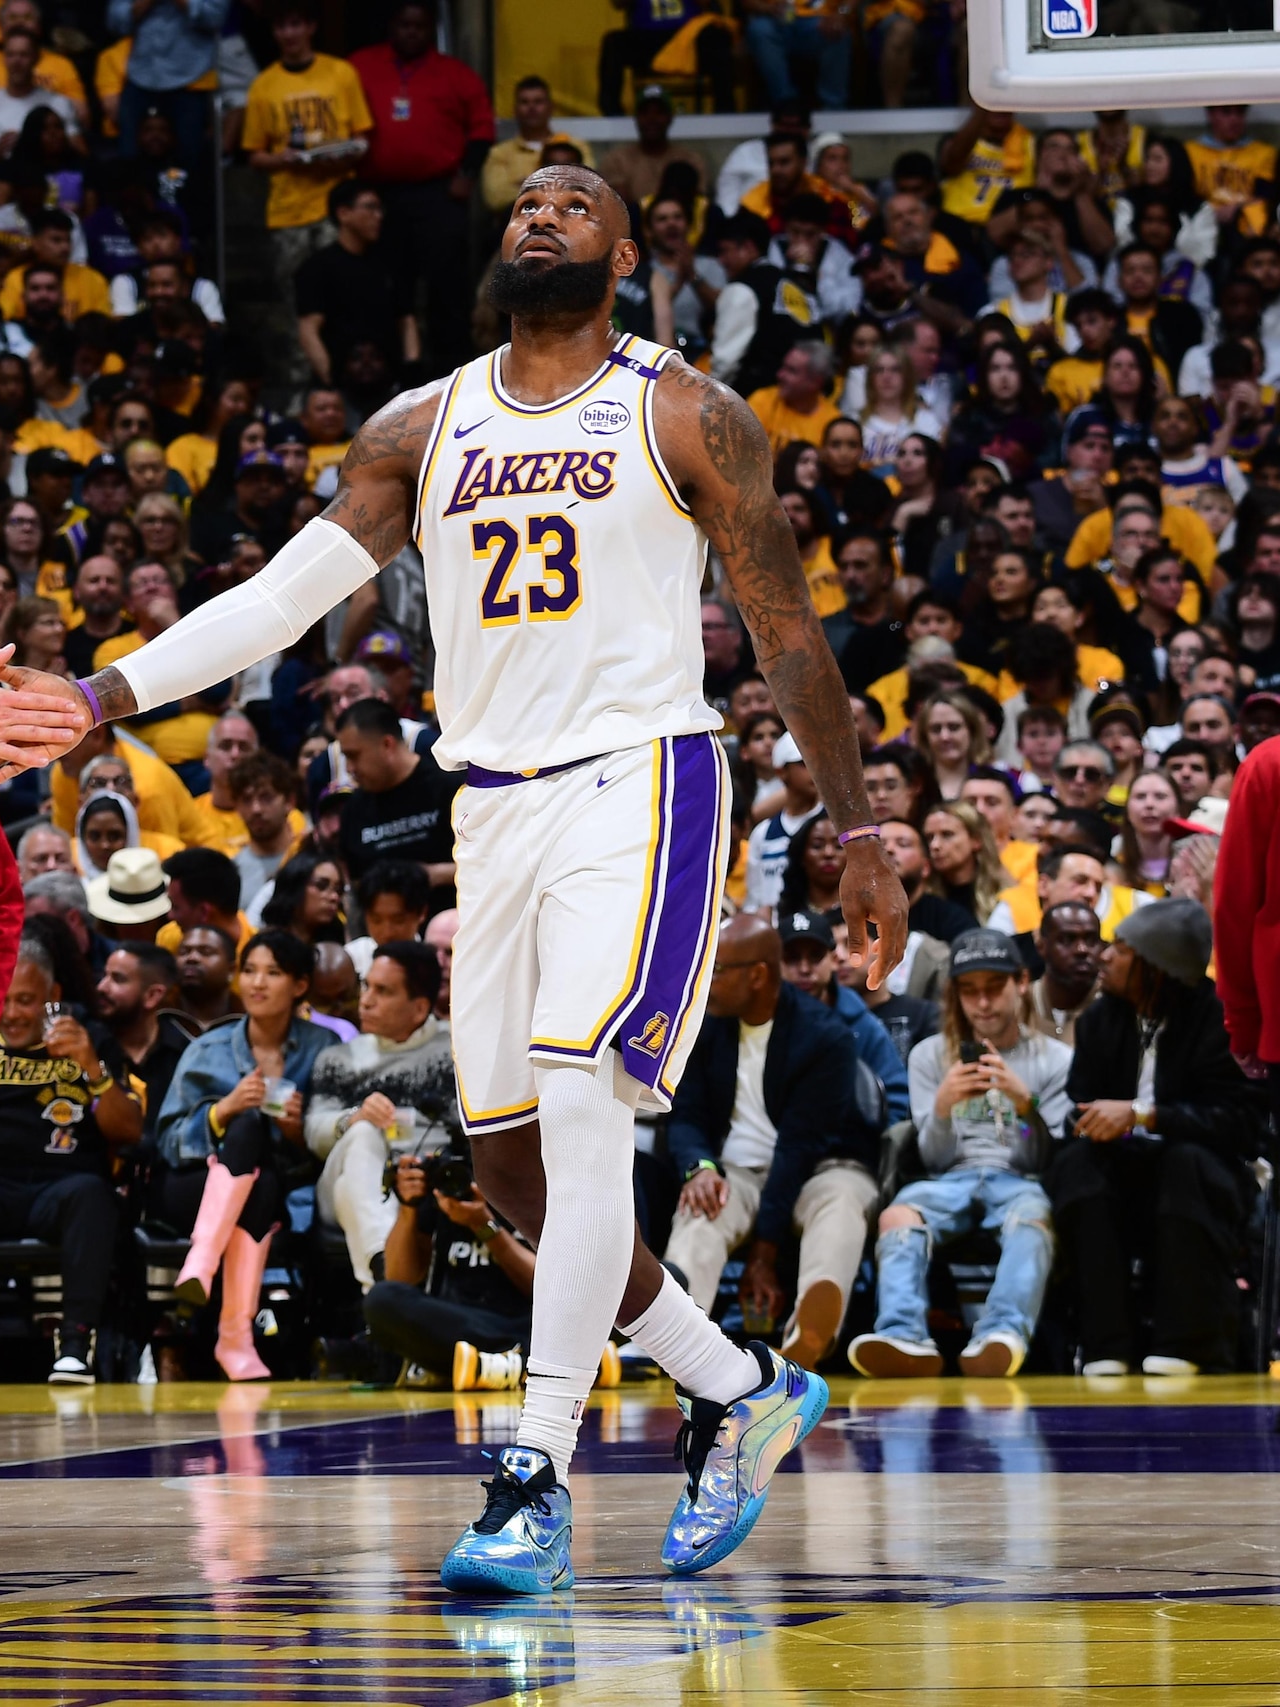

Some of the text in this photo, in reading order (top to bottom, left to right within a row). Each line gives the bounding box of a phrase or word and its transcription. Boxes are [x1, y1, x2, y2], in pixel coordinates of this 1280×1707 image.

[1051, 10, 1078, 30] NBA
[584, 409, 627, 425] bibigo
[441, 445, 620, 521] LAKERS
[470, 512, 583, 629] 23
